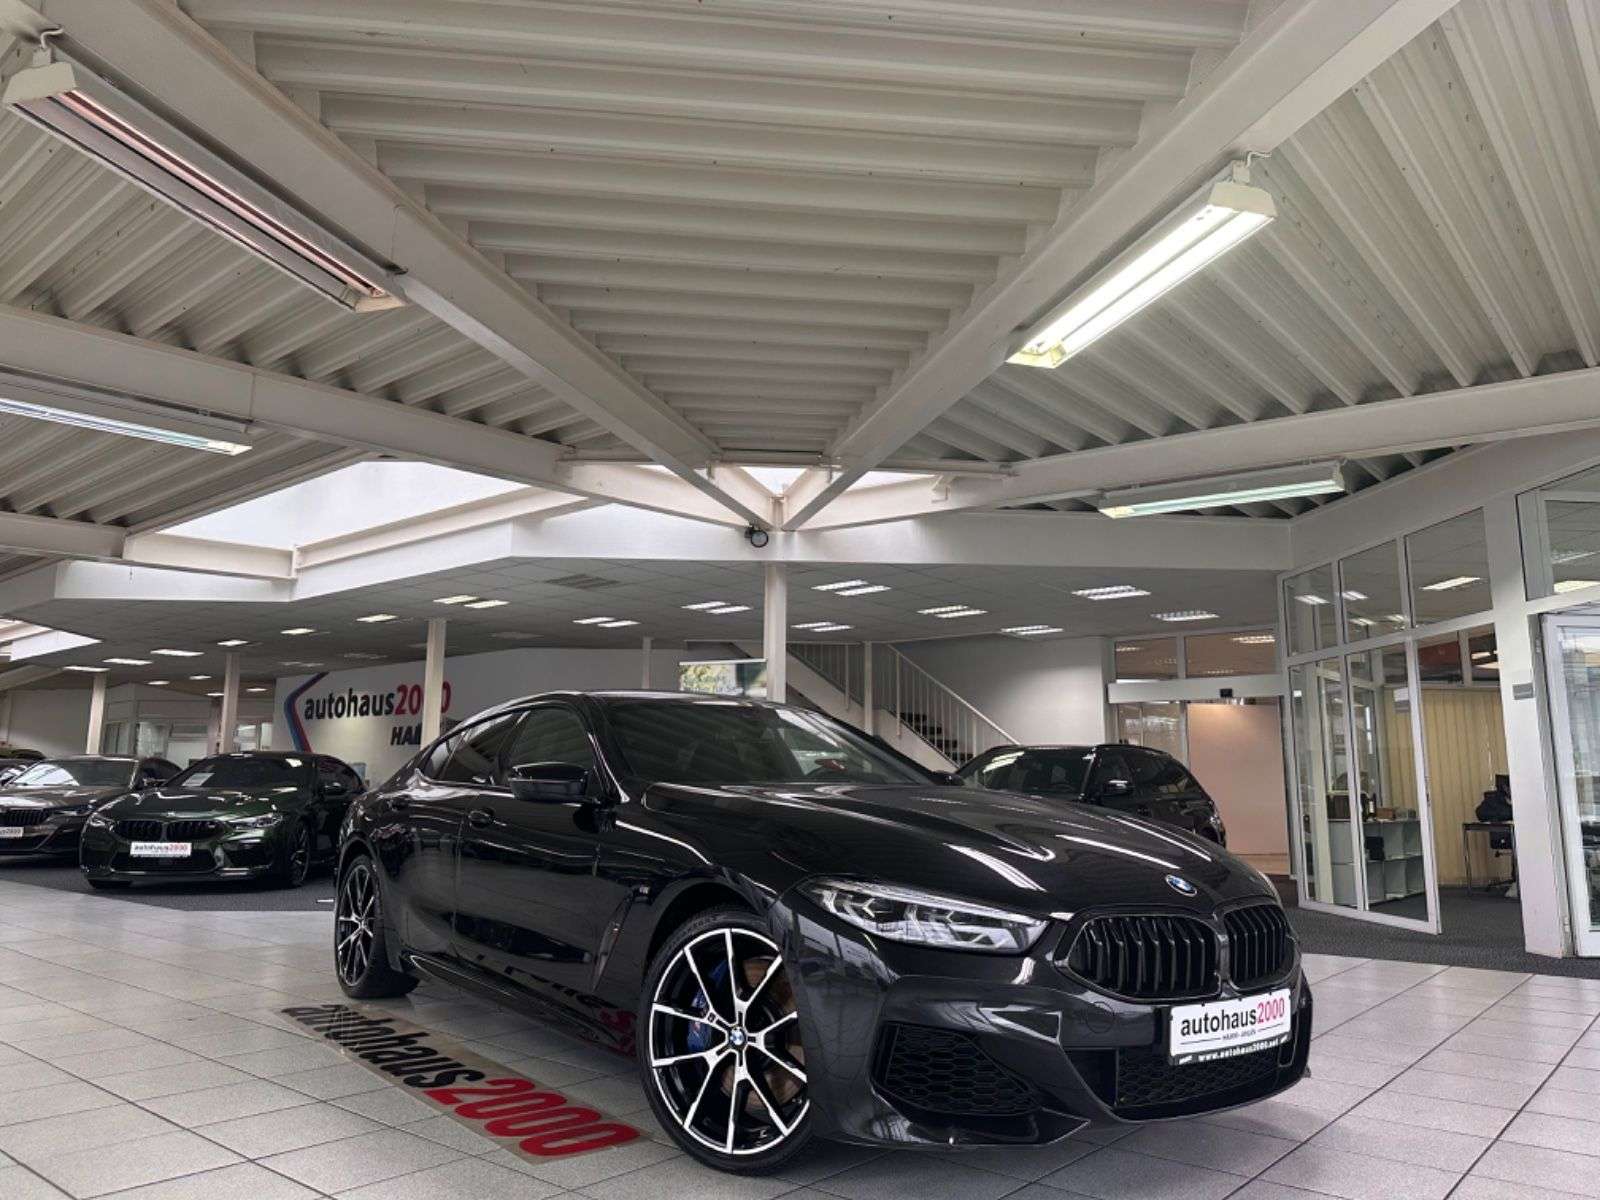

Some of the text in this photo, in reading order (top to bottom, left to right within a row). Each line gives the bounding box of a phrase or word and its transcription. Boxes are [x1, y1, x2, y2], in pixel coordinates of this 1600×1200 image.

[304, 681, 451, 720] autohaus200
[1180, 997, 1285, 1036] autohaus2000
[281, 1004, 641, 1156] autohaus2000
